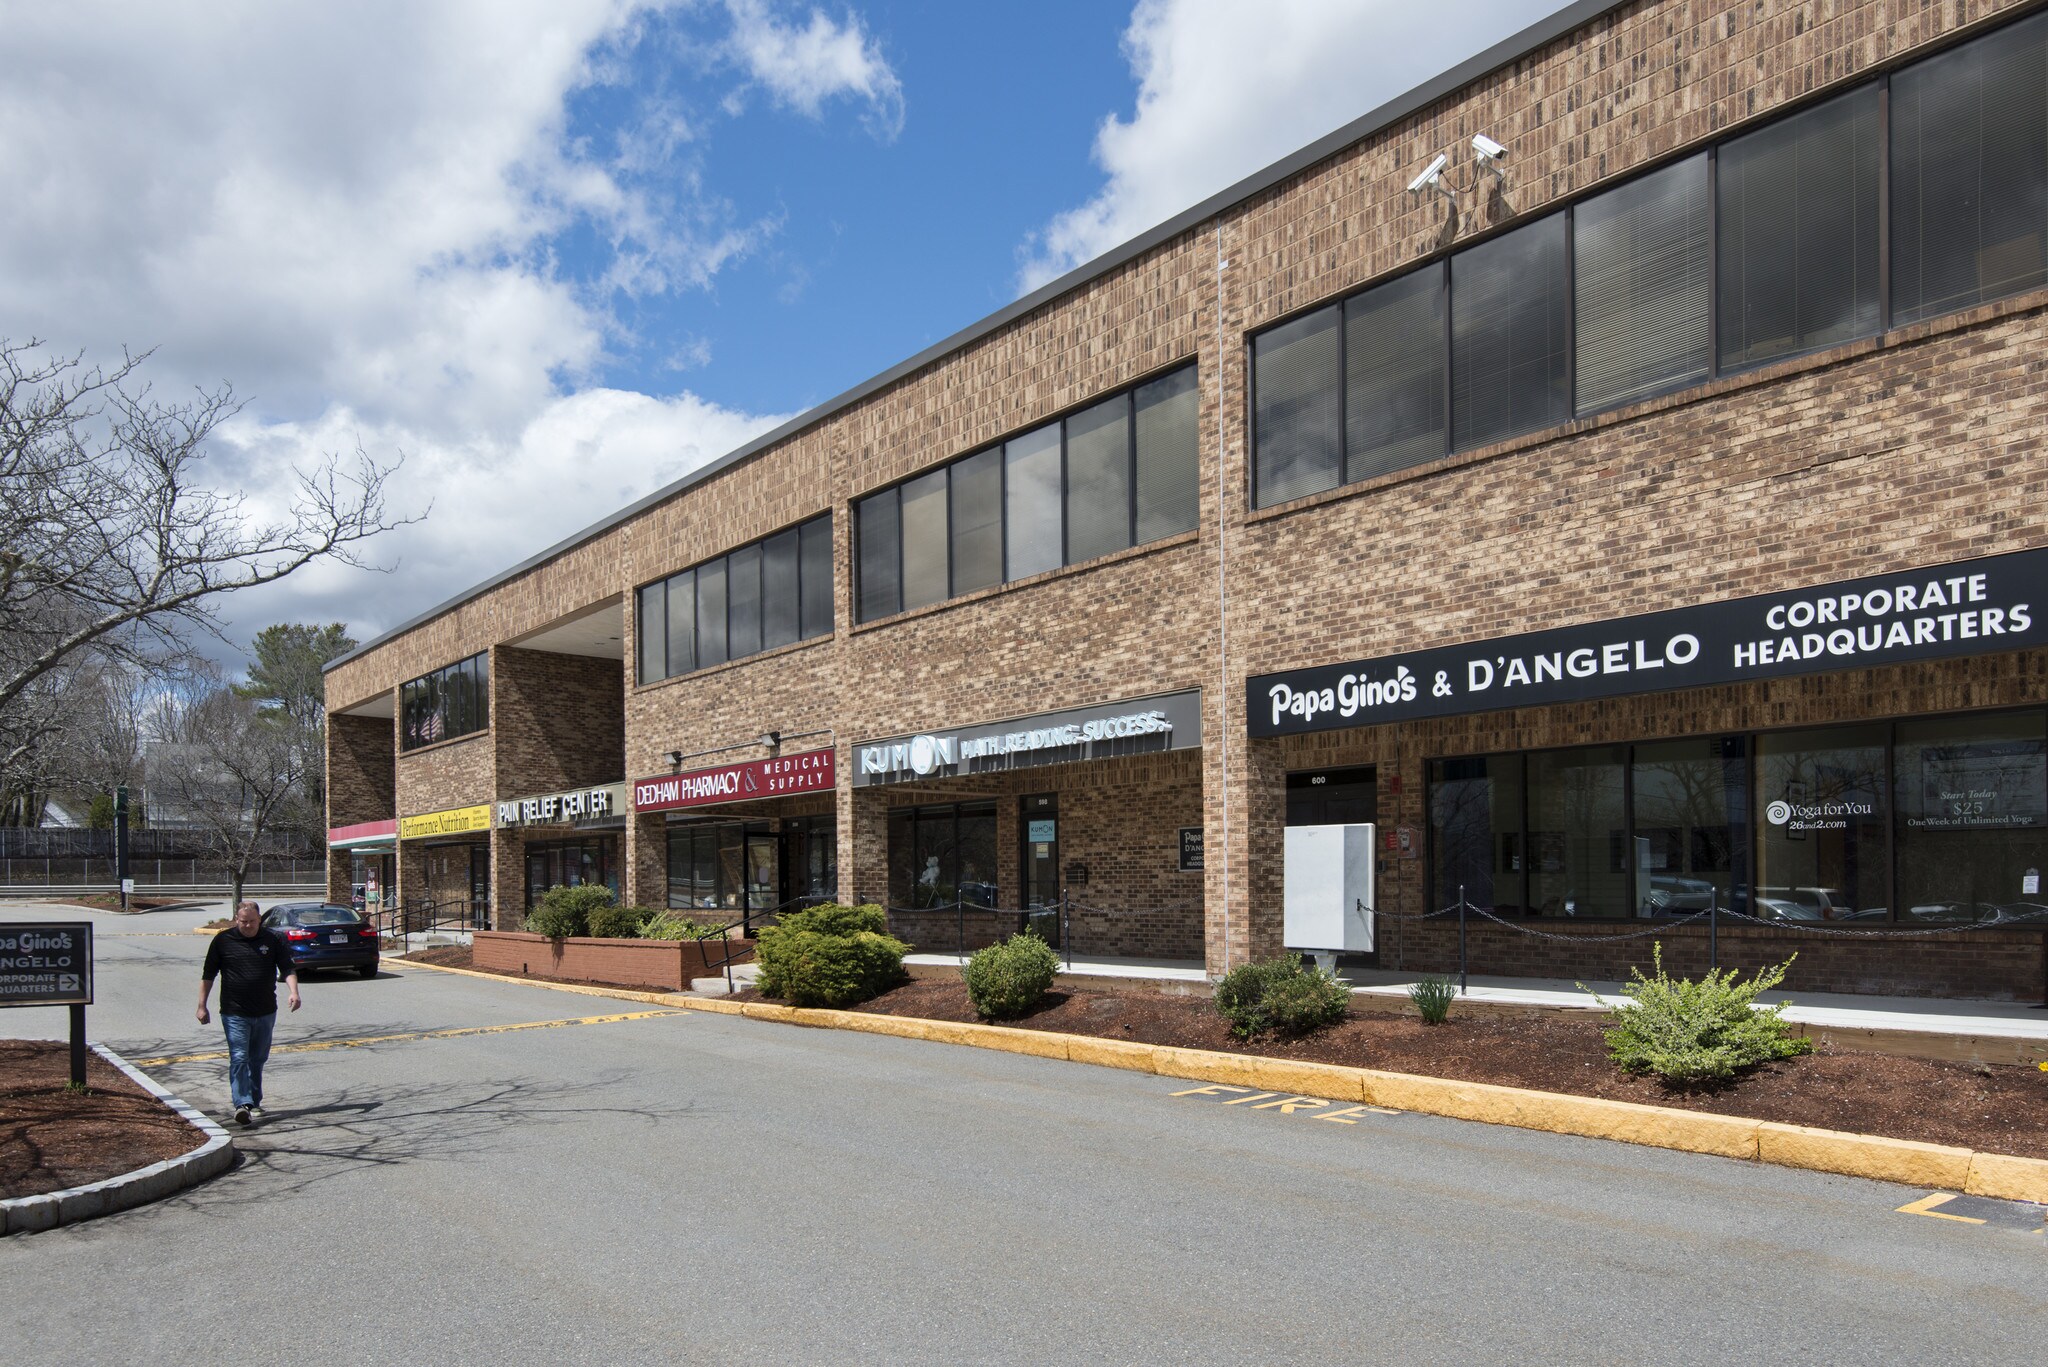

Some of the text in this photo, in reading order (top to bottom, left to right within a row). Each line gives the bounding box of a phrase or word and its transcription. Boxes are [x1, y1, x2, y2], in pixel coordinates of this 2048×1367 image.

[1766, 573, 1987, 631] CORPORATE
[1734, 603, 2032, 668] HEADQUARTERS
[1268, 633, 1700, 726] Papa Gino's & D'ANGELO
[764, 754, 829, 775] MEDICAL
[861, 735, 958, 774] KUMON
[636, 767, 759, 806] DEDHAM PHARMACY &
[769, 772, 823, 791] SUPPLY
[1311, 776, 1326, 785] 600
[1940, 789, 1997, 802] Start Today
[499, 789, 608, 823] PAIN RELIEF CENTER
[1790, 802, 1872, 820] Yoga for You
[1953, 801, 1983, 816] $25
[402, 811, 470, 837] Performance Nutrition
[1031, 824, 1053, 833] KUMON
[1789, 820, 1847, 830] 26and2.com
[1907, 815, 2033, 827] One Week of Unlimited Yoga
[1184, 832, 1201, 843] Papa
[19, 932, 73, 953] Gino's
[0, 956, 71, 969] NGELO
[1168, 1085, 1402, 1125] FIRE
